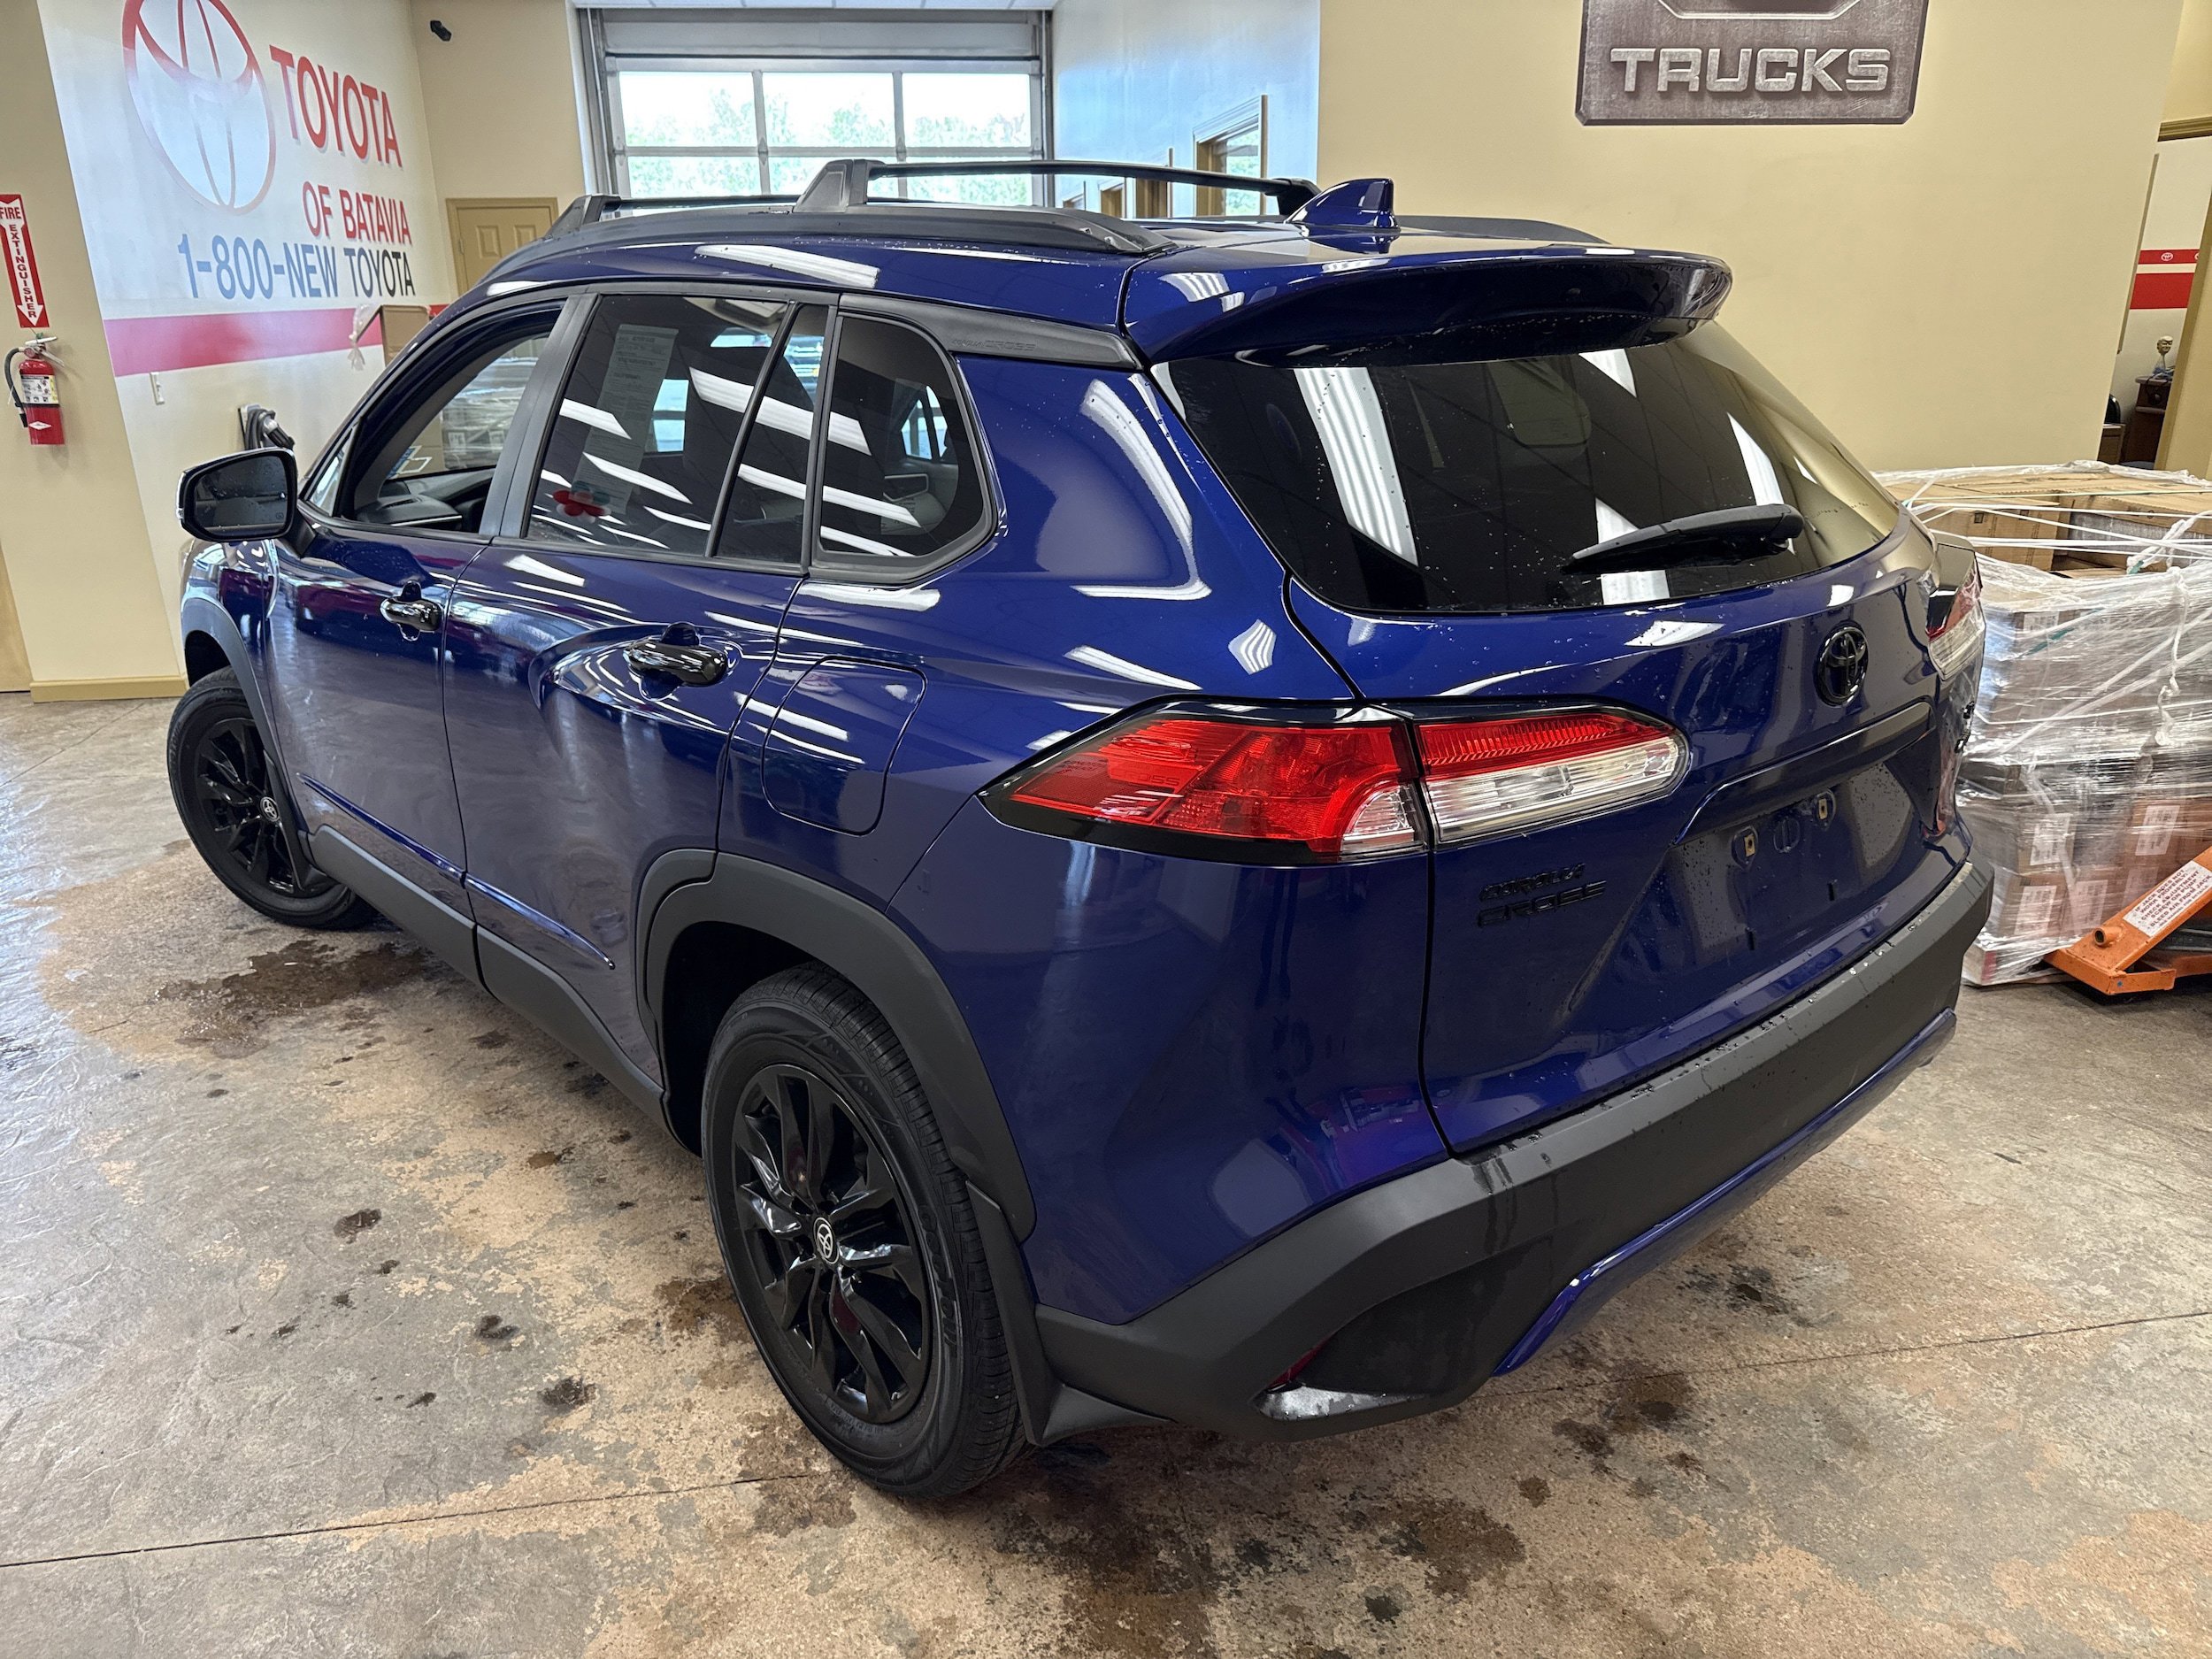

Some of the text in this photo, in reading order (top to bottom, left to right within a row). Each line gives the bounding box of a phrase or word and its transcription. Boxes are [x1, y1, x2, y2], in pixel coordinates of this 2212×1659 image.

[1609, 47, 1891, 92] TRUCKS
[269, 44, 403, 168] TOYOTA
[0, 207, 21, 219] FIRE
[302, 180, 412, 244] OF BATAVIA
[9, 224, 36, 318] EXTINGUISHER
[177, 234, 416, 299] 1-800-NEW TOYOTA
[985, 340, 1036, 351] CROSS
[1477, 879, 1607, 928] CROSS
[2141, 903, 2161, 920] CHECK
[2142, 893, 2156, 905] JACK
